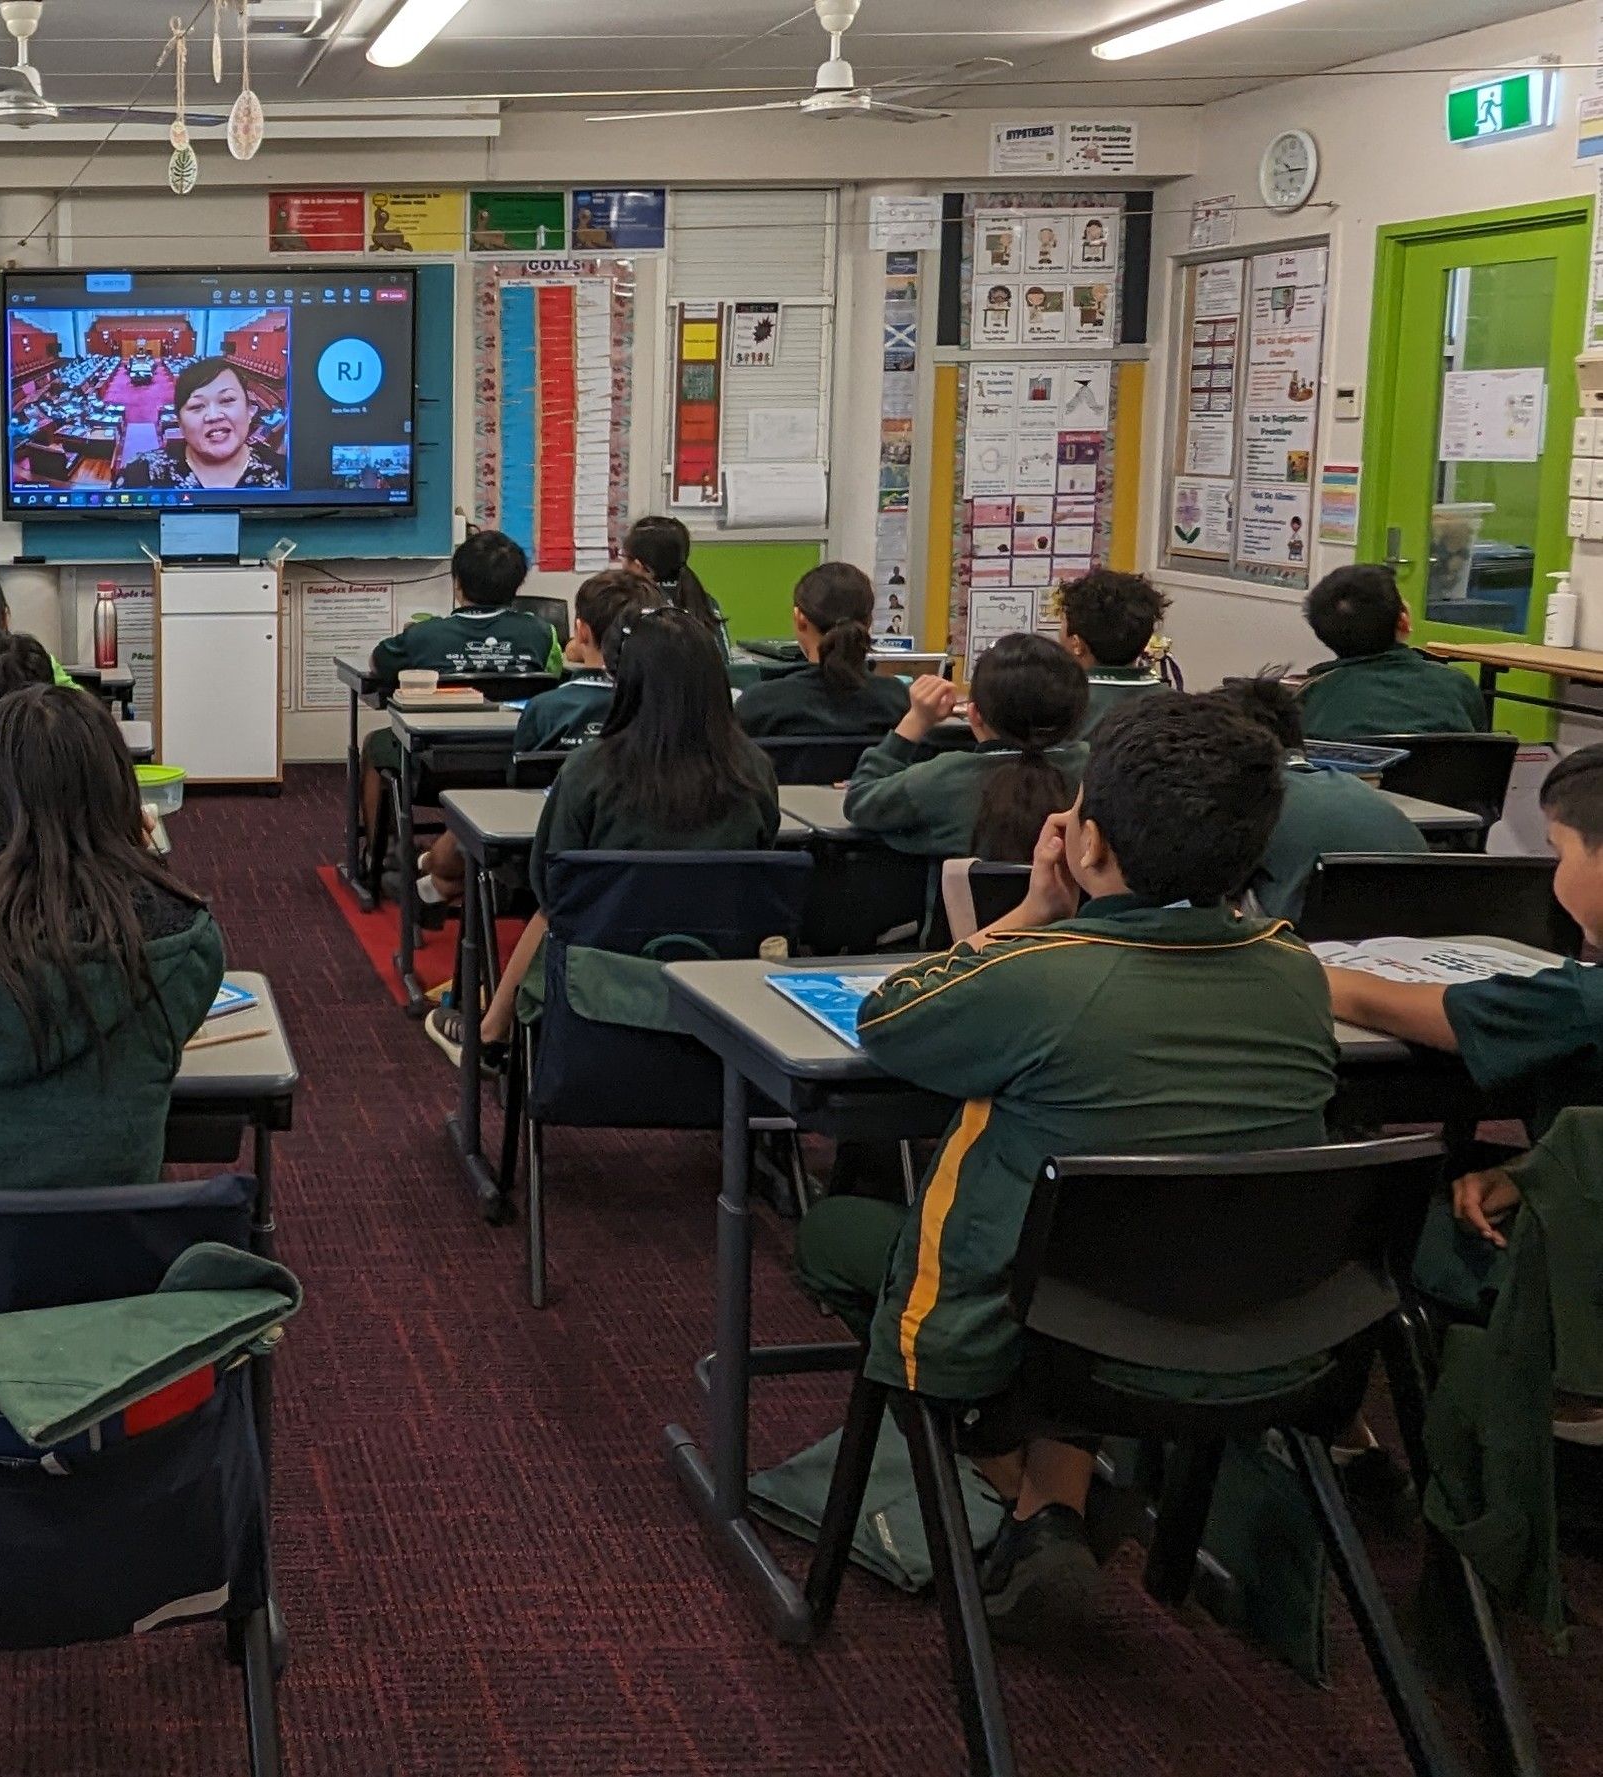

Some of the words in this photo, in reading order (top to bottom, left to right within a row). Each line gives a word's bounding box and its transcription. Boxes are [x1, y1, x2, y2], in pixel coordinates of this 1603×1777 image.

[1005, 126, 1054, 140] HYPOTHESIS
[527, 260, 581, 271] GOALS
[337, 361, 363, 381] RJ
[307, 586, 346, 595] Complex
[348, 585, 389, 594] Sentences
